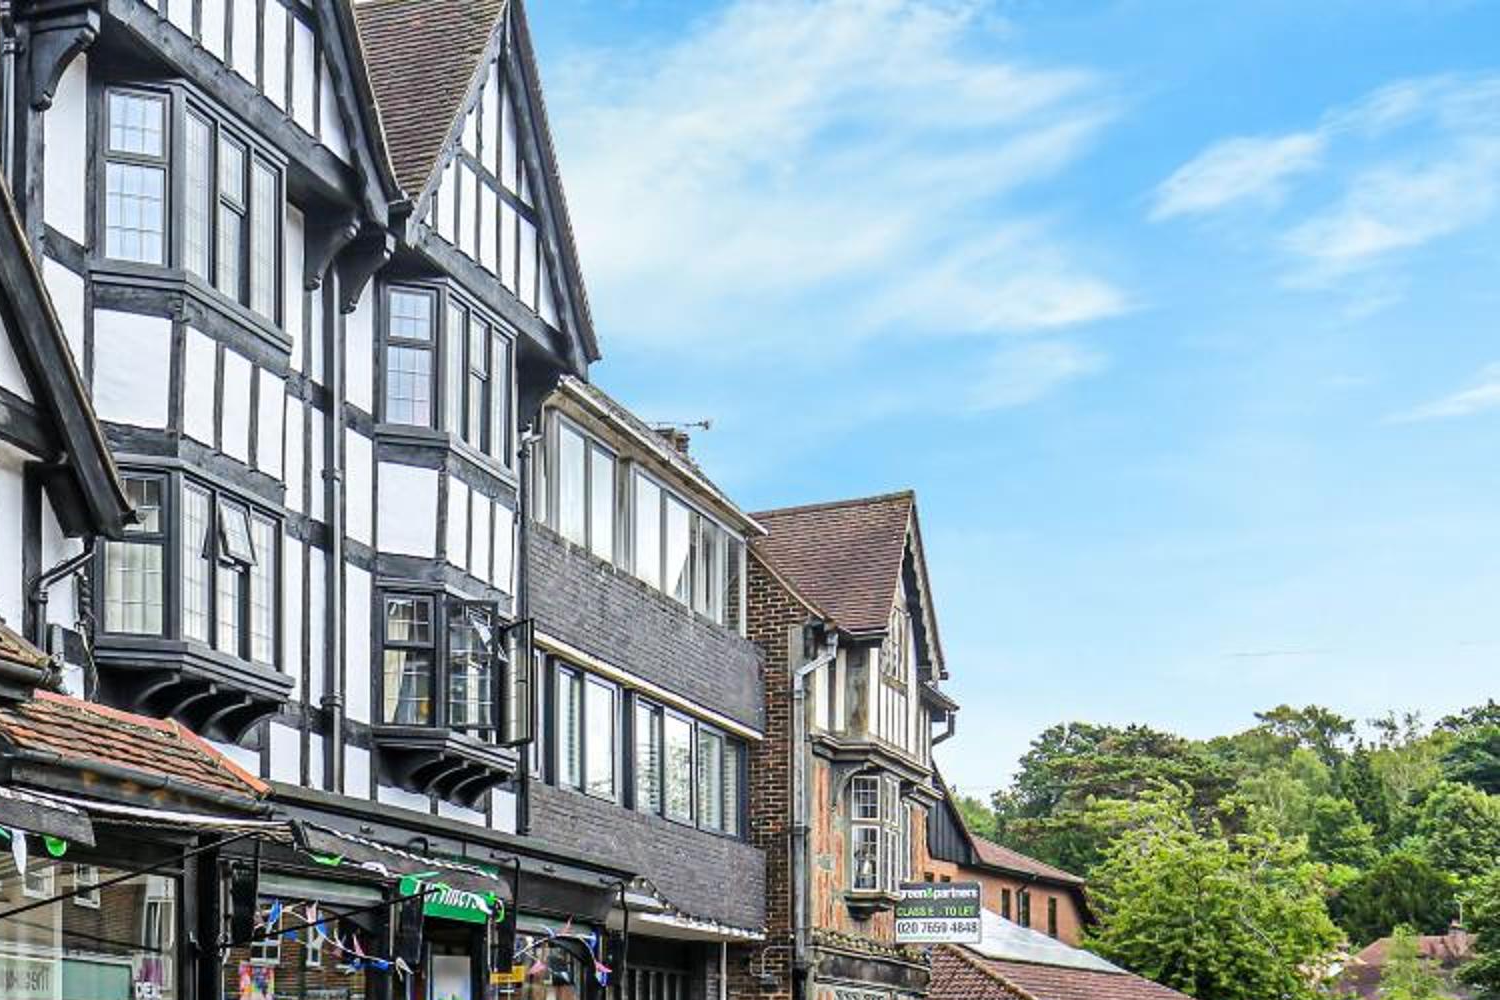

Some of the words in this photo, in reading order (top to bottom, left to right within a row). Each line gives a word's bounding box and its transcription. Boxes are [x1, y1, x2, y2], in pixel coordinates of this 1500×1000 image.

[897, 906, 926, 916] CLASS
[945, 906, 956, 916] TO
[958, 906, 975, 916] LET
[897, 922, 918, 934] 020
